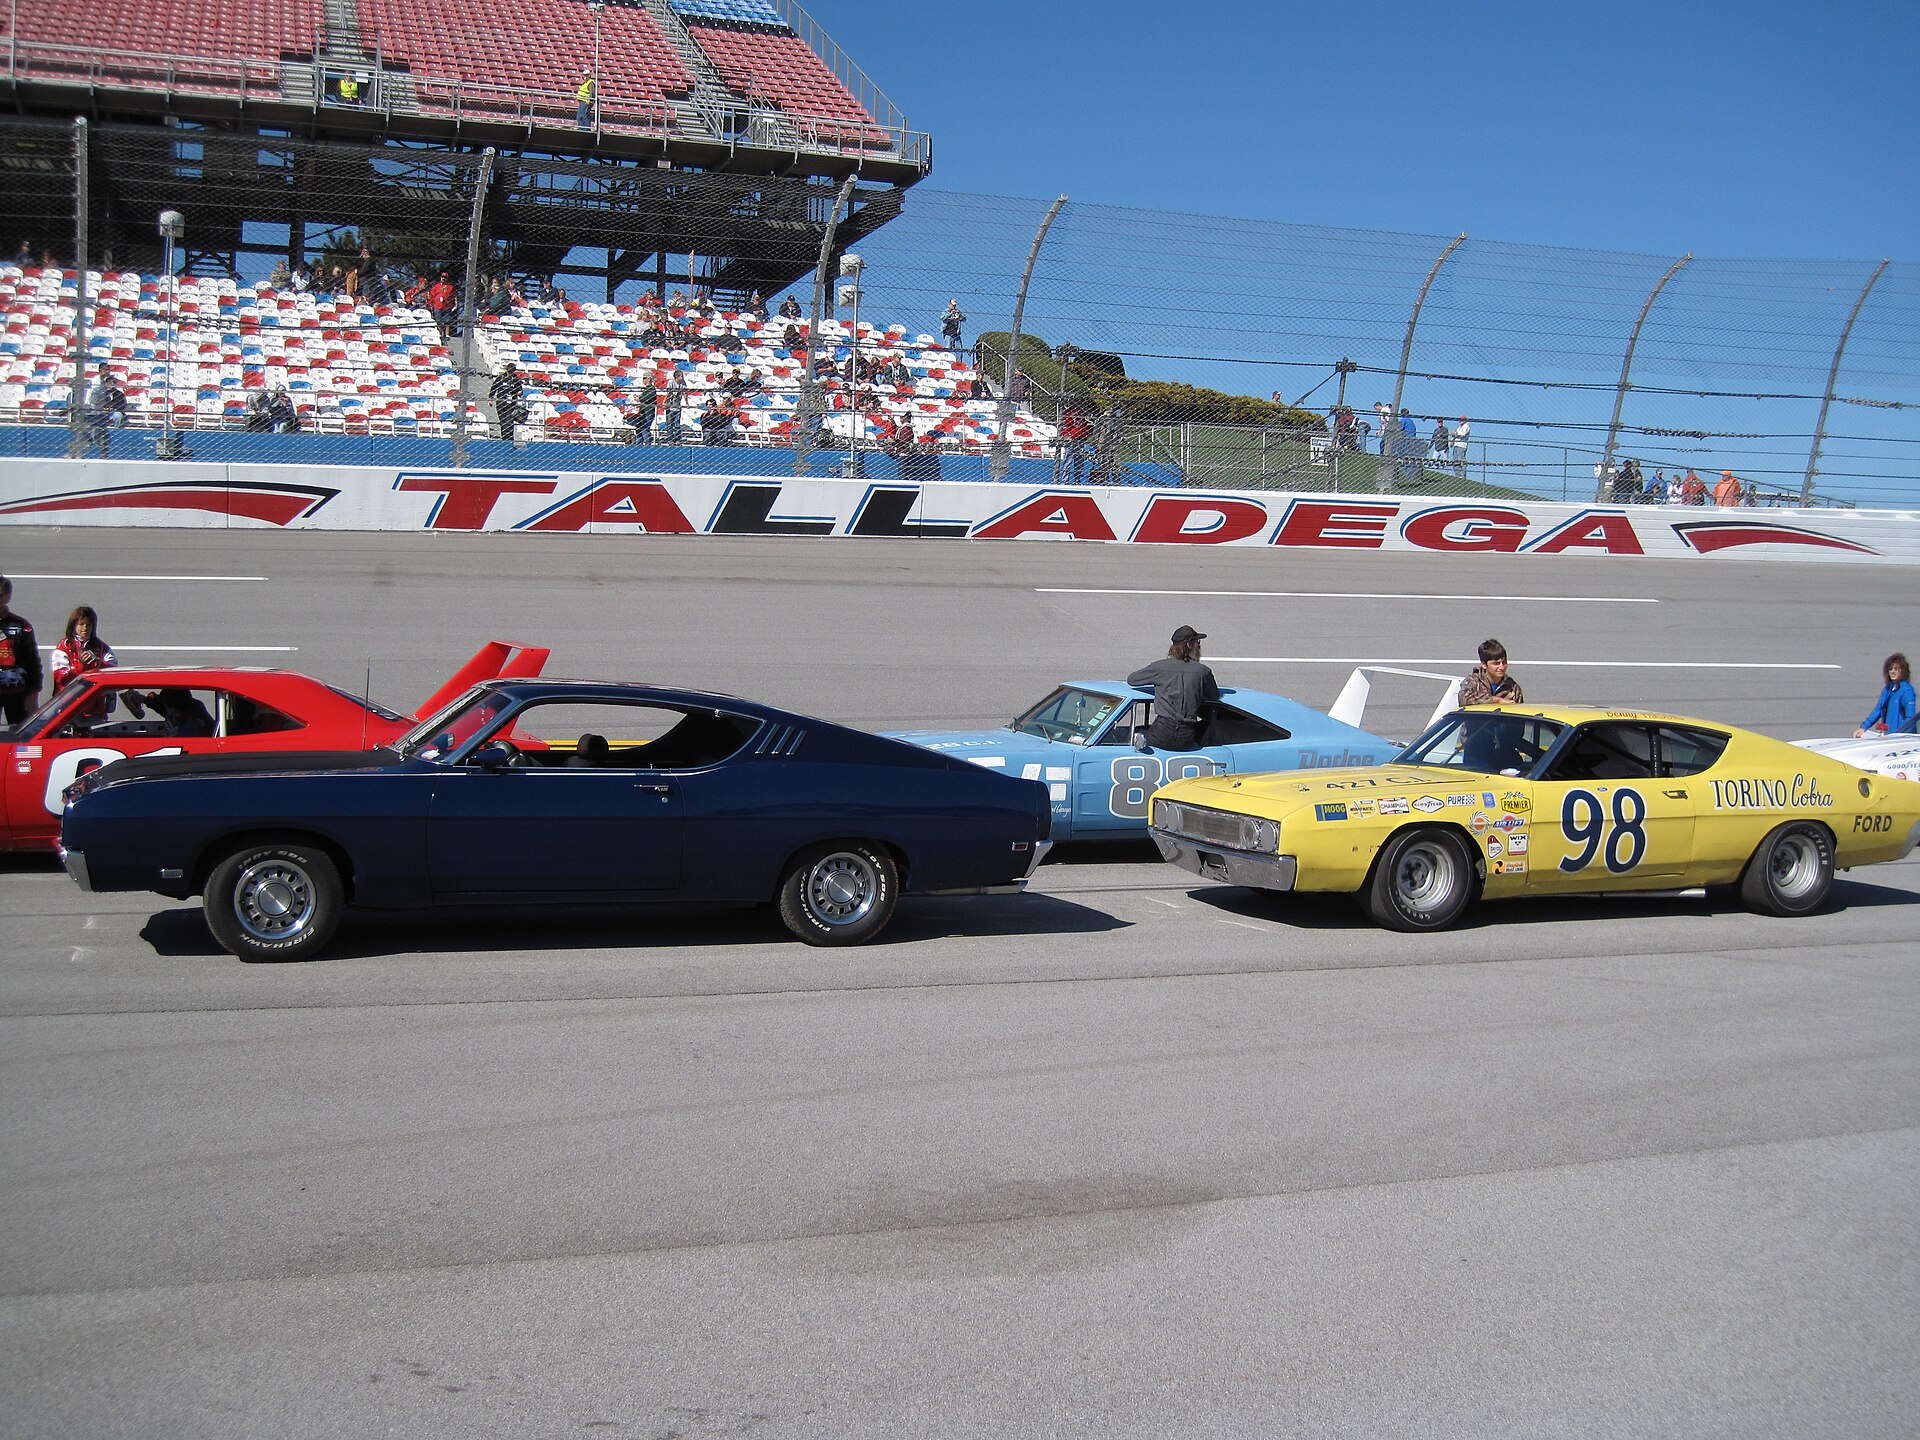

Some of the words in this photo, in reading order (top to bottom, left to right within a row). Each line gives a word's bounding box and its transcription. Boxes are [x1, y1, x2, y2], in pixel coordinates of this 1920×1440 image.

[393, 472, 1645, 555] TALLADEGA
[1887, 761, 1920, 774] GOODYE
[1326, 779, 1376, 789] 427
[1709, 778, 1787, 809] TORINO
[1789, 772, 1834, 808] Cobra
[1324, 803, 1346, 813] MOOG
[1447, 795, 1466, 805] PURE
[1503, 800, 1529, 810] PREMIER
[1558, 786, 1647, 875] 98
[1853, 815, 1892, 833] FORD
[238, 850, 273, 870] INDY
[278, 850, 308, 864] 500
[239, 926, 316, 950] FIREHAWK
